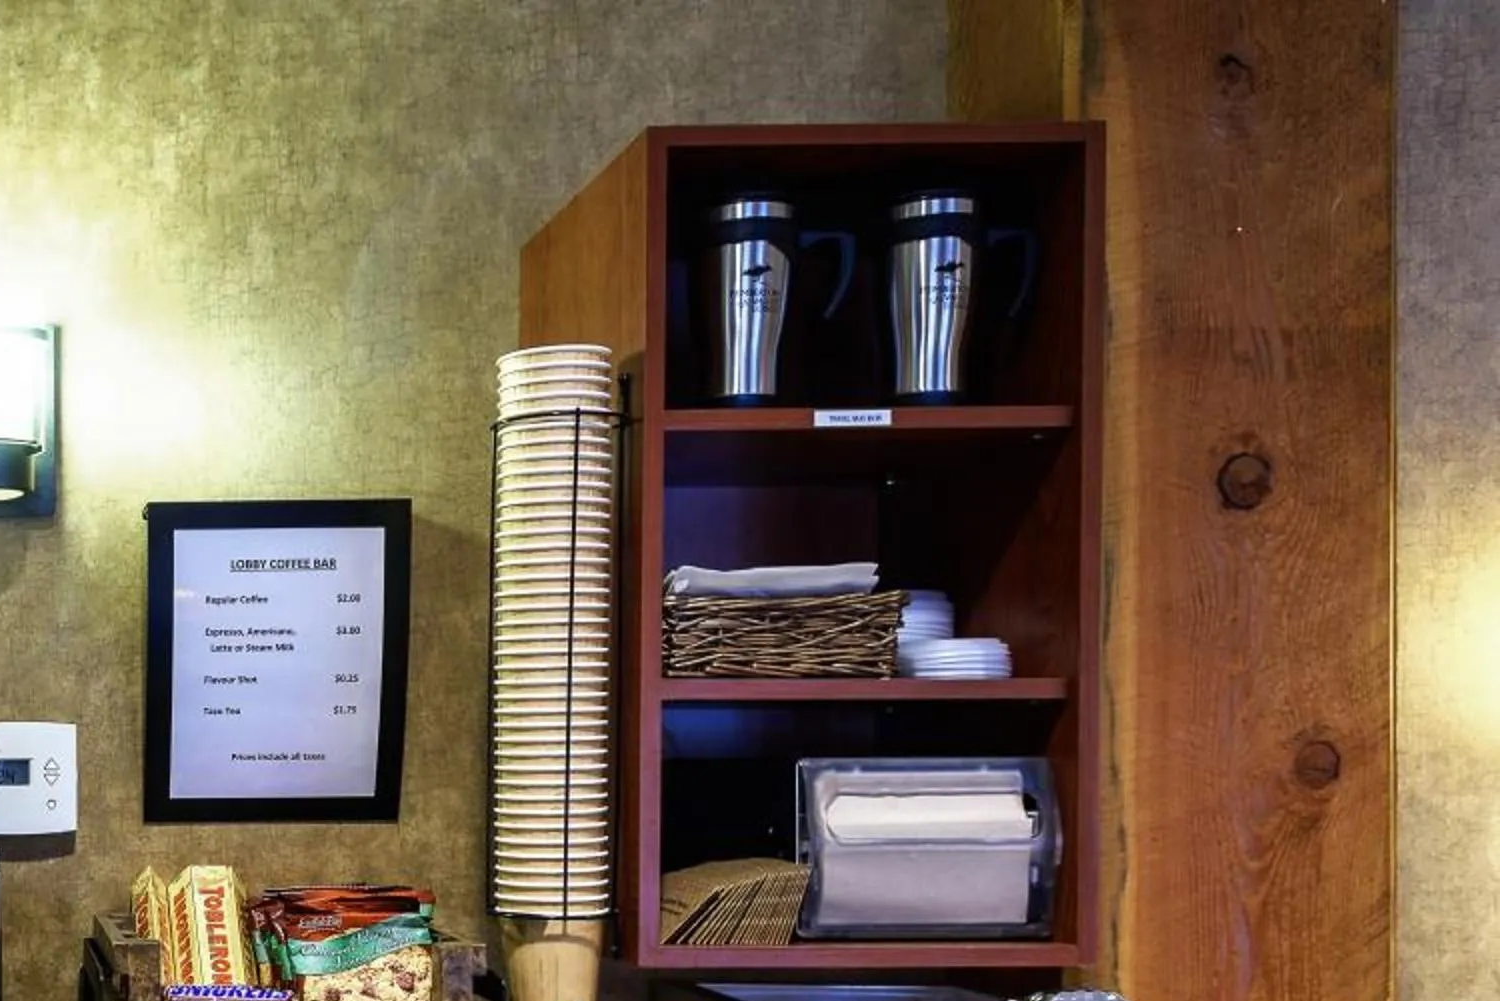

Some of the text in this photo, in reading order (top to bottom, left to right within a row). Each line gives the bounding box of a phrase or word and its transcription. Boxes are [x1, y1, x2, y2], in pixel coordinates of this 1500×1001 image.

[230, 558, 337, 570] LOBBY COFFEE BAR
[240, 592, 269, 604] Coffee
[211, 644, 233, 653] Latte
[225, 707, 241, 715] Tea
[332, 705, 357, 715] $1.75
[199, 886, 233, 985] TOBLERON
